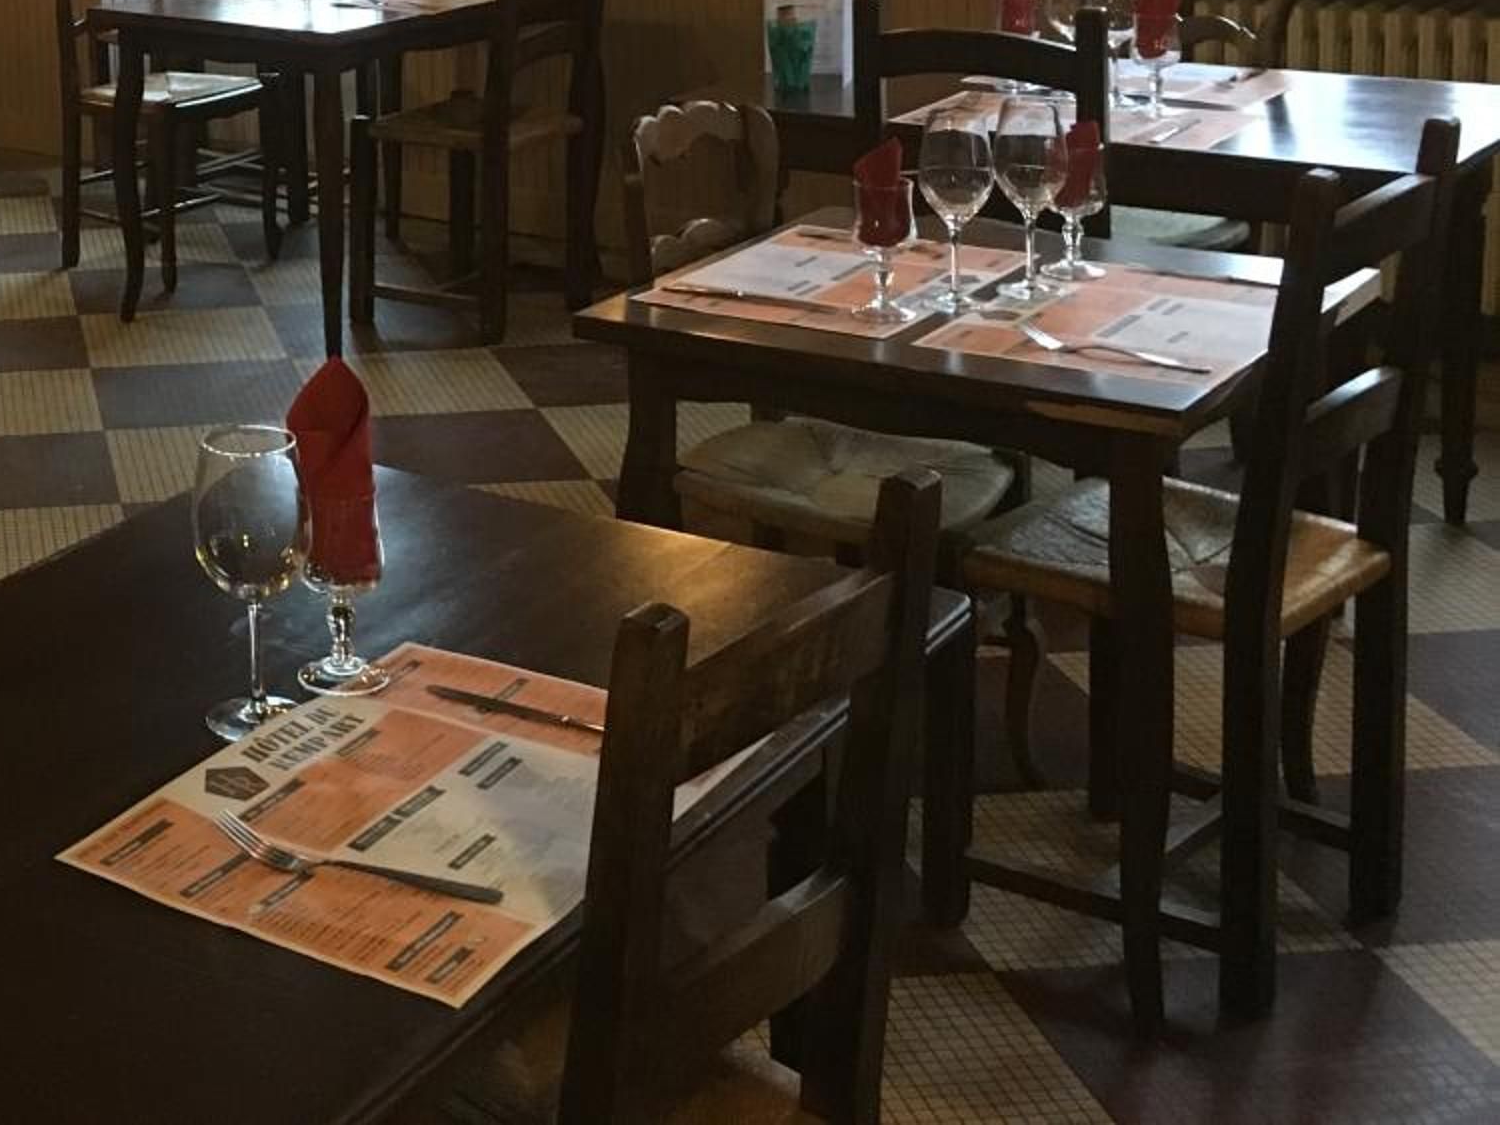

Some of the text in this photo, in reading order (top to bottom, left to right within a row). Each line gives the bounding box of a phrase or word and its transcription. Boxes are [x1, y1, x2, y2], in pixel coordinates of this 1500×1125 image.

[241, 721, 313, 763] HÔTEL
[304, 704, 341, 726] DU
[267, 715, 365, 771] REMPART
